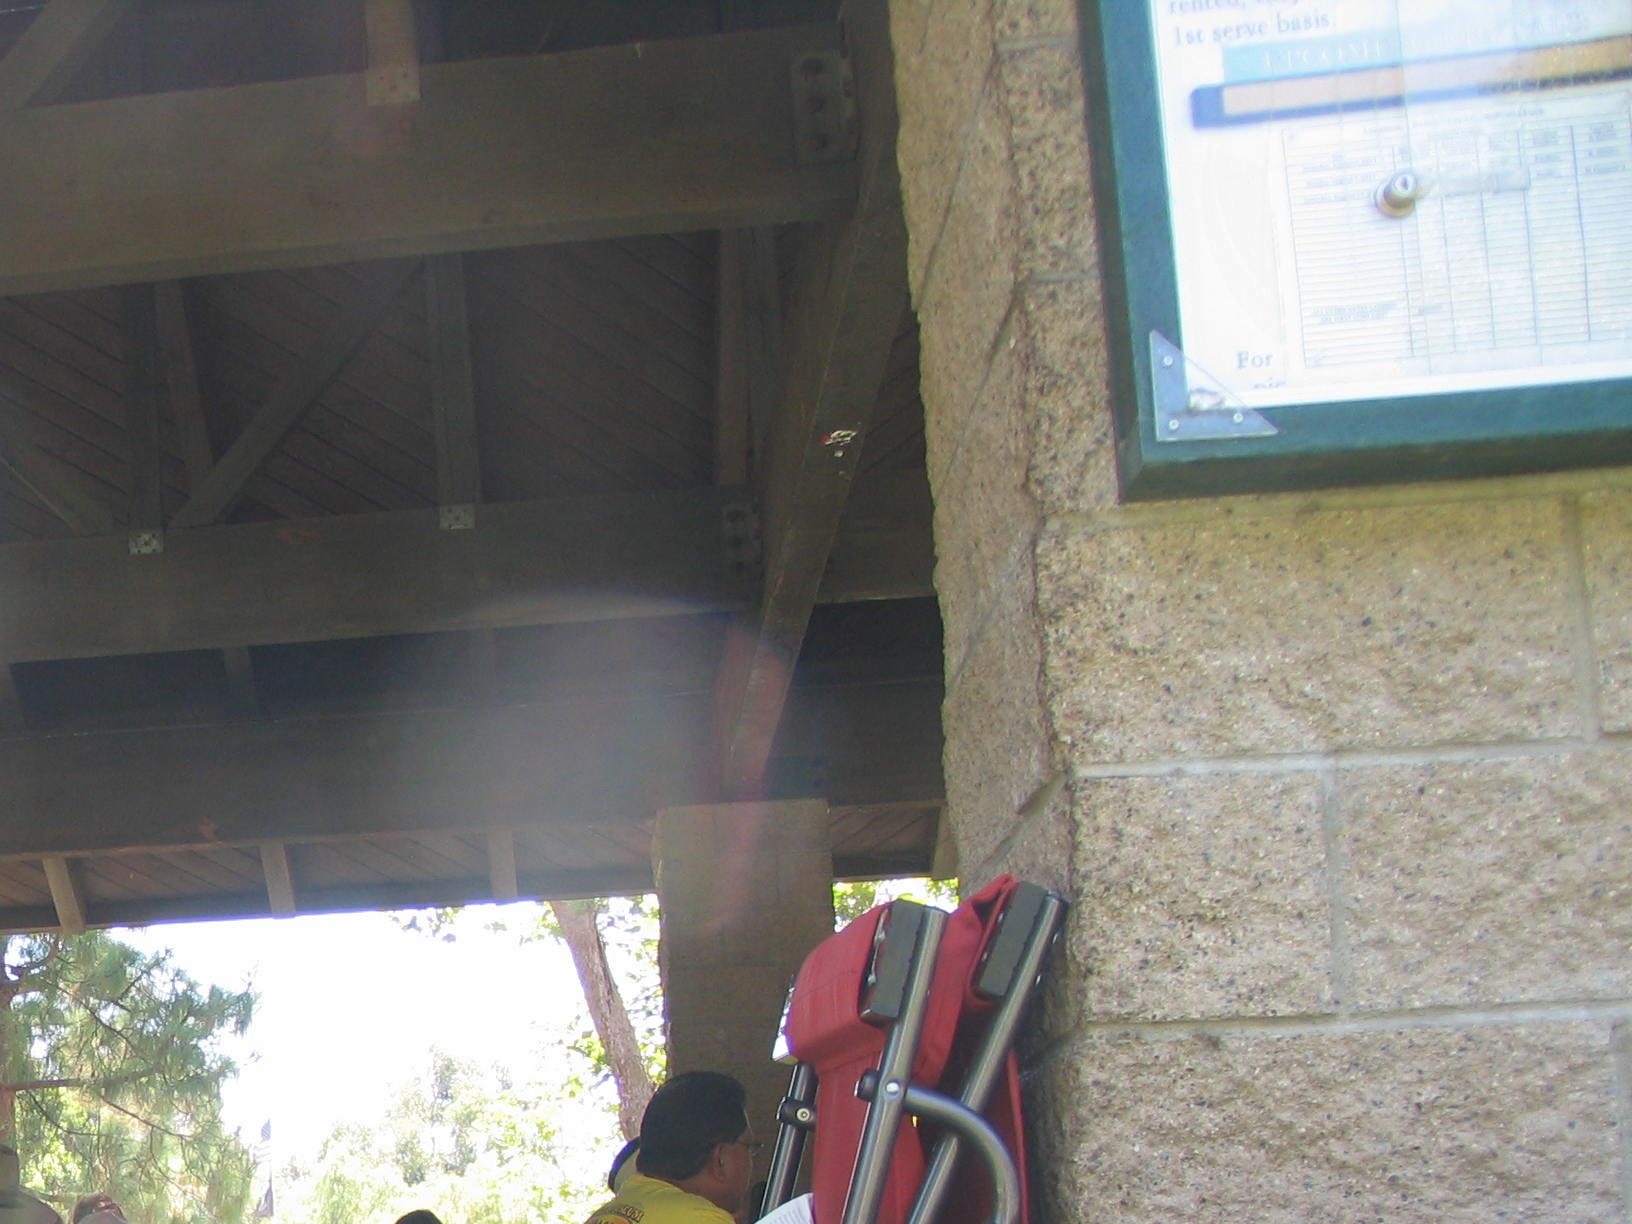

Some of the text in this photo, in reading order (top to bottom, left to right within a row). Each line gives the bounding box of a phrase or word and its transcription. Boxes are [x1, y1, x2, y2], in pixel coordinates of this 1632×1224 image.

[1174, 26, 1205, 46] 1st
[1211, 22, 1268, 42] serve
[1236, 350, 1275, 369] For
